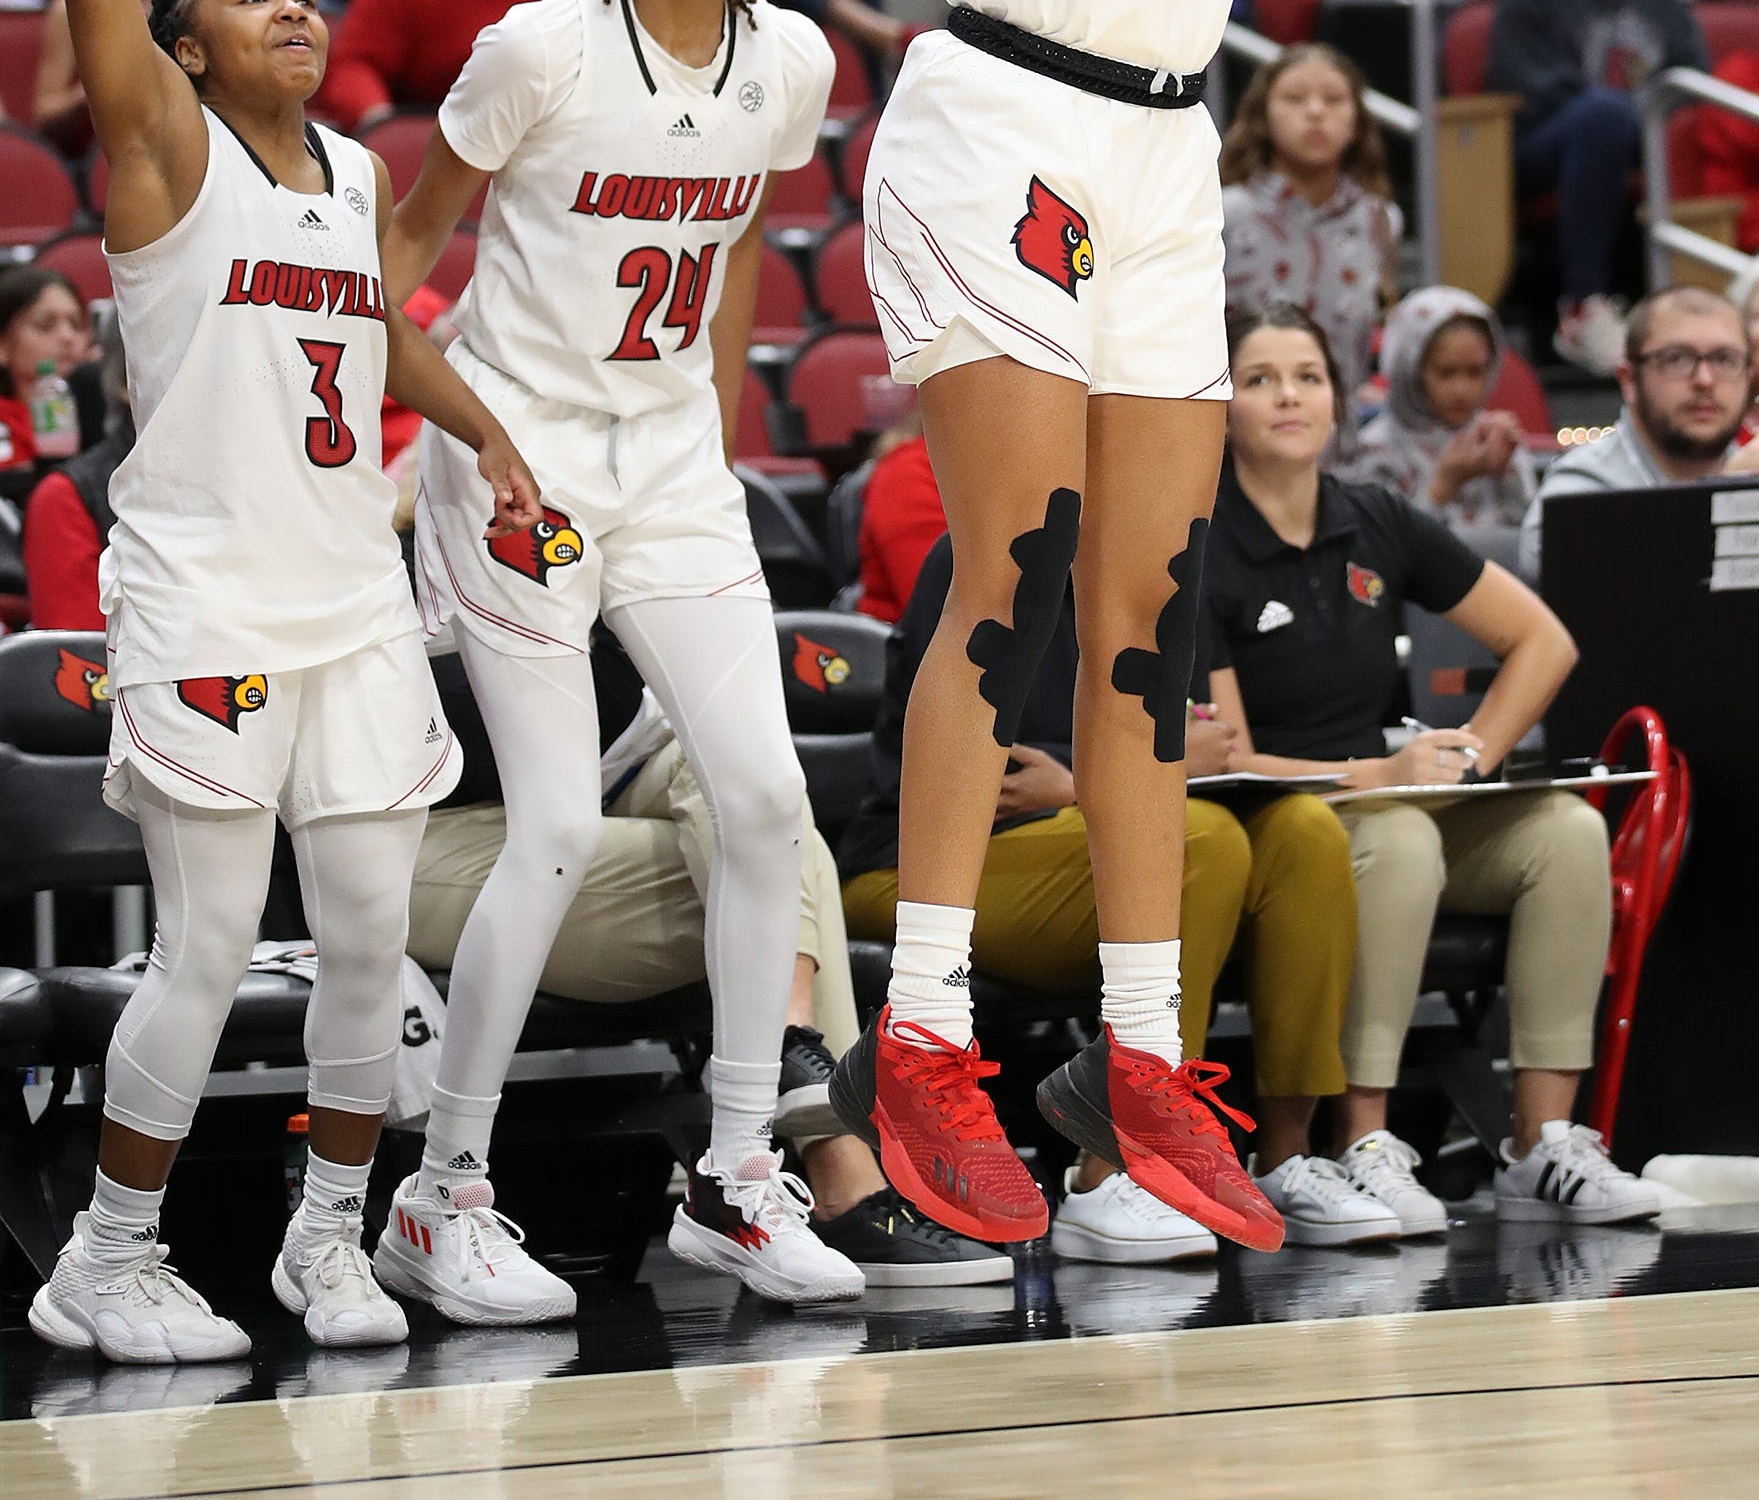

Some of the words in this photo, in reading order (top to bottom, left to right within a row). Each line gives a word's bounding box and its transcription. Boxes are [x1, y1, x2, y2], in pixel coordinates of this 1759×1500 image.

[667, 127, 701, 138] adidas
[601, 242, 720, 361] 24
[296, 337, 357, 467] 3
[447, 1160, 481, 1170] adidas
